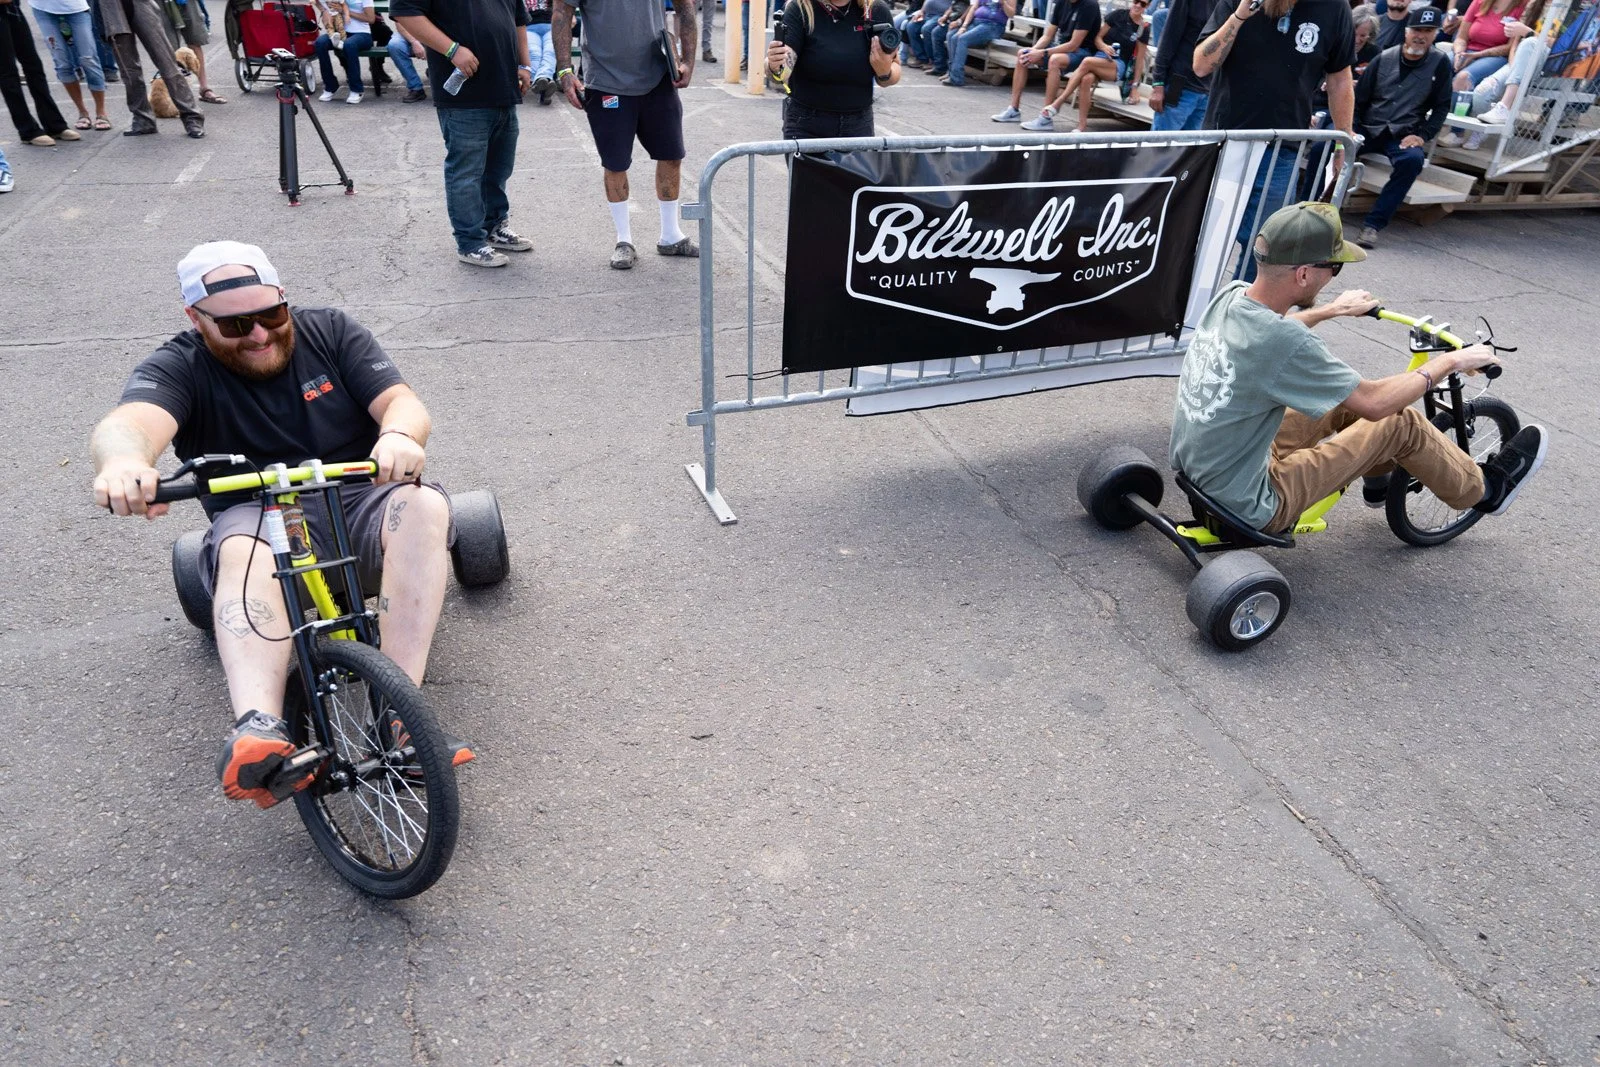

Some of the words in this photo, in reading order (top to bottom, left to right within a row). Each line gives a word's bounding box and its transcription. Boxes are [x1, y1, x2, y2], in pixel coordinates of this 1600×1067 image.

[855, 197, 1075, 263] Biltwell
[1078, 193, 1156, 258] Inc.
[870, 270, 957, 289] "QUALITY
[1073, 260, 1140, 282] COUNTS"
